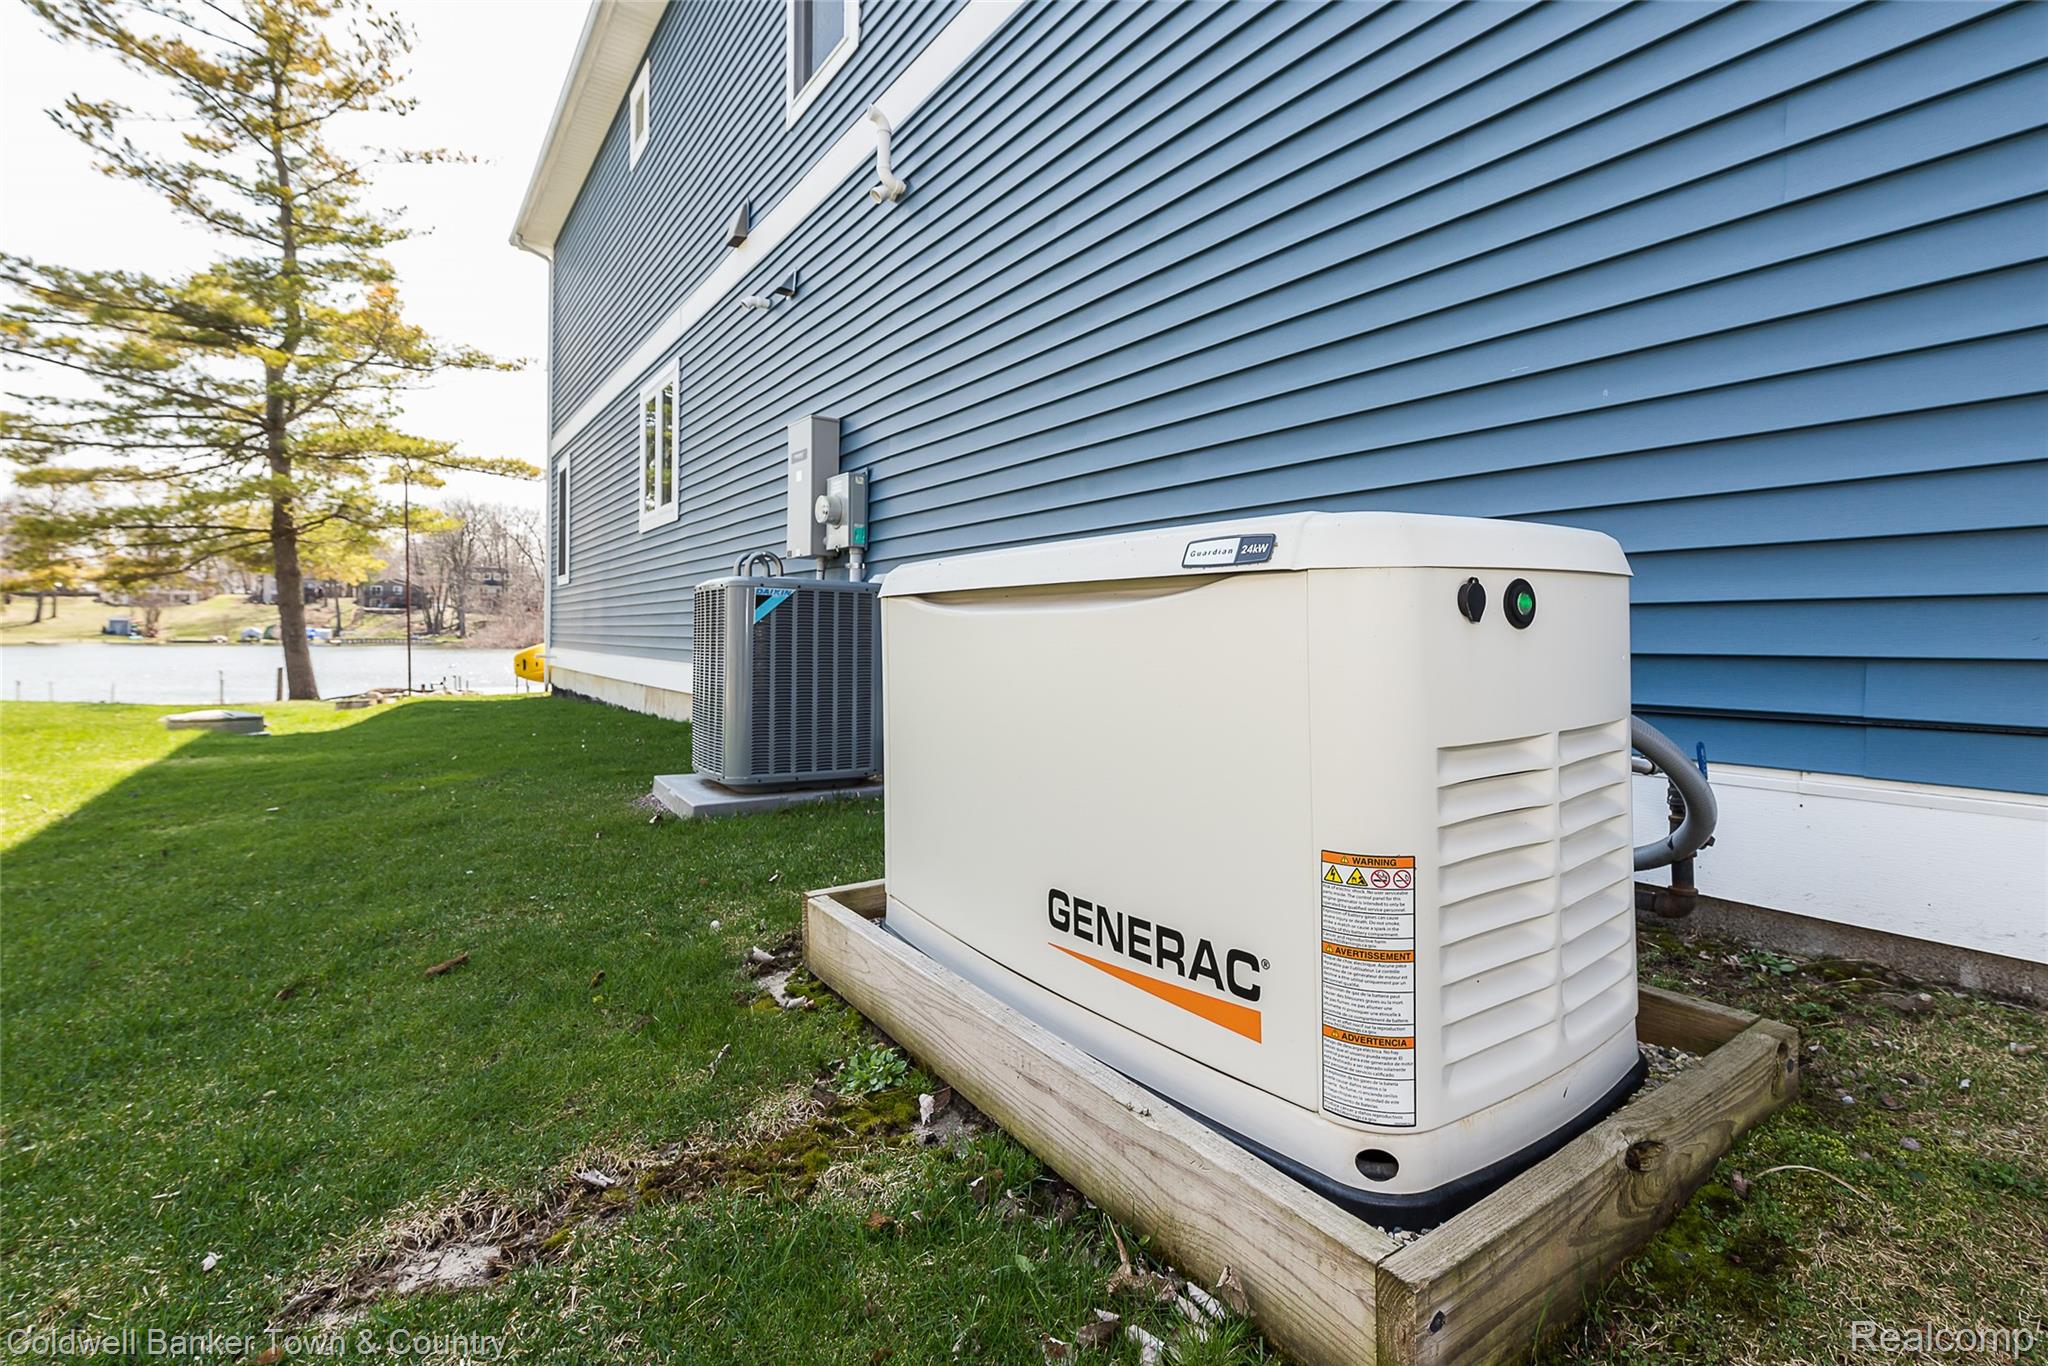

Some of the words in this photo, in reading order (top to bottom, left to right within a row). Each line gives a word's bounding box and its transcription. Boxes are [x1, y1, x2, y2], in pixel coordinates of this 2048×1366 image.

[1190, 548, 1233, 558] Guardian
[1241, 543, 1269, 554] 24kW
[756, 588, 792, 596] DAIKIN
[1352, 856, 1397, 866] WARNING
[1048, 888, 1261, 1002] GENERAC
[1335, 947, 1411, 961] AVERTISSEMENT
[1342, 1033, 1407, 1047] ADVERTENCIA
